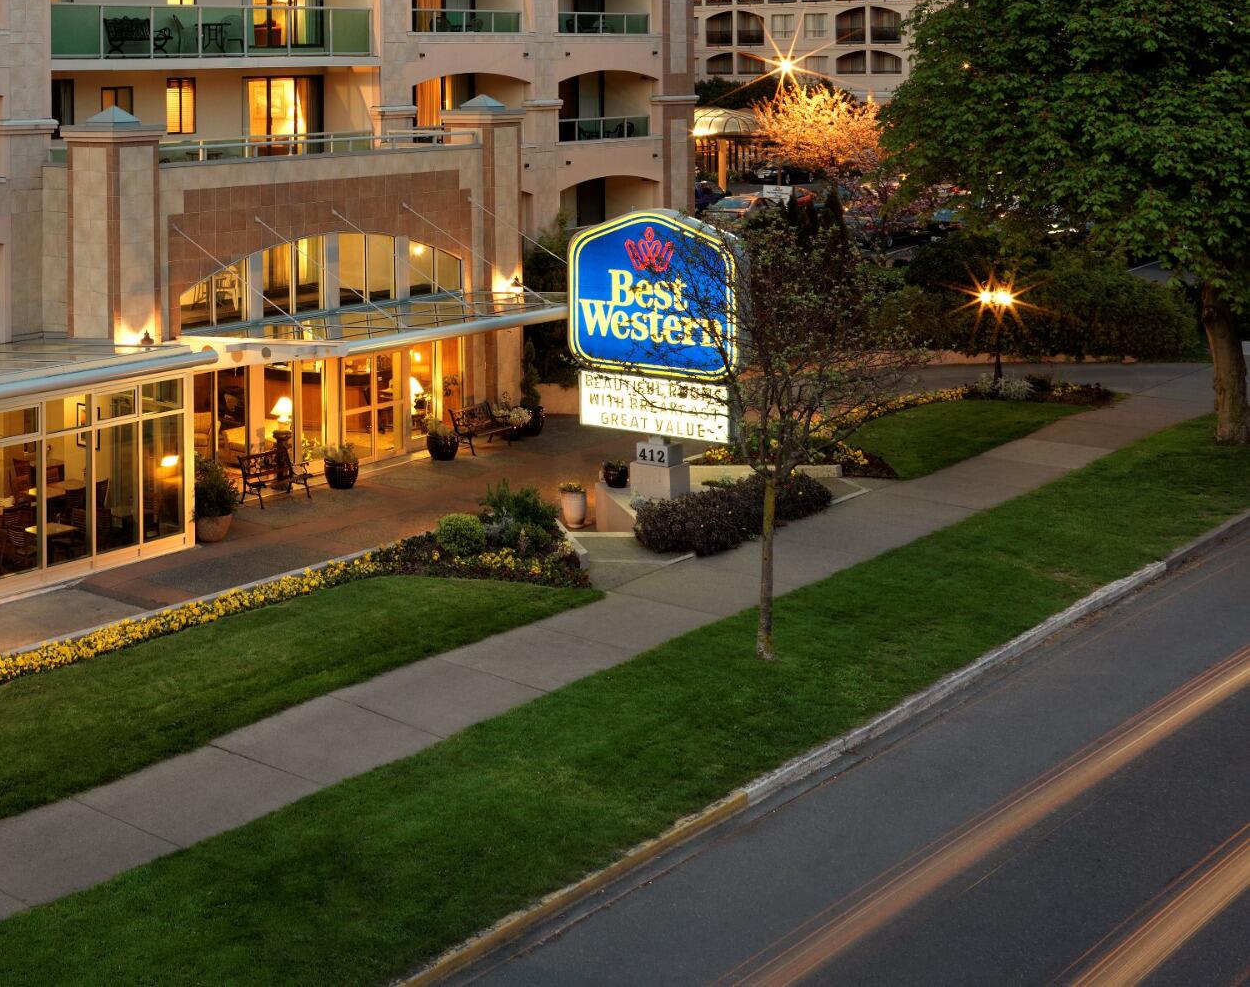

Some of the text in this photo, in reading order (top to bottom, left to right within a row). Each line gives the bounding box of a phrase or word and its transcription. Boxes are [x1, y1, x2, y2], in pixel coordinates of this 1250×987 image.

[608, 268, 687, 312] Best
[578, 298, 723, 348] Western
[589, 393, 624, 409] WITH
[601, 411, 705, 438] GREAT VALUE
[638, 448, 666, 464] 412
